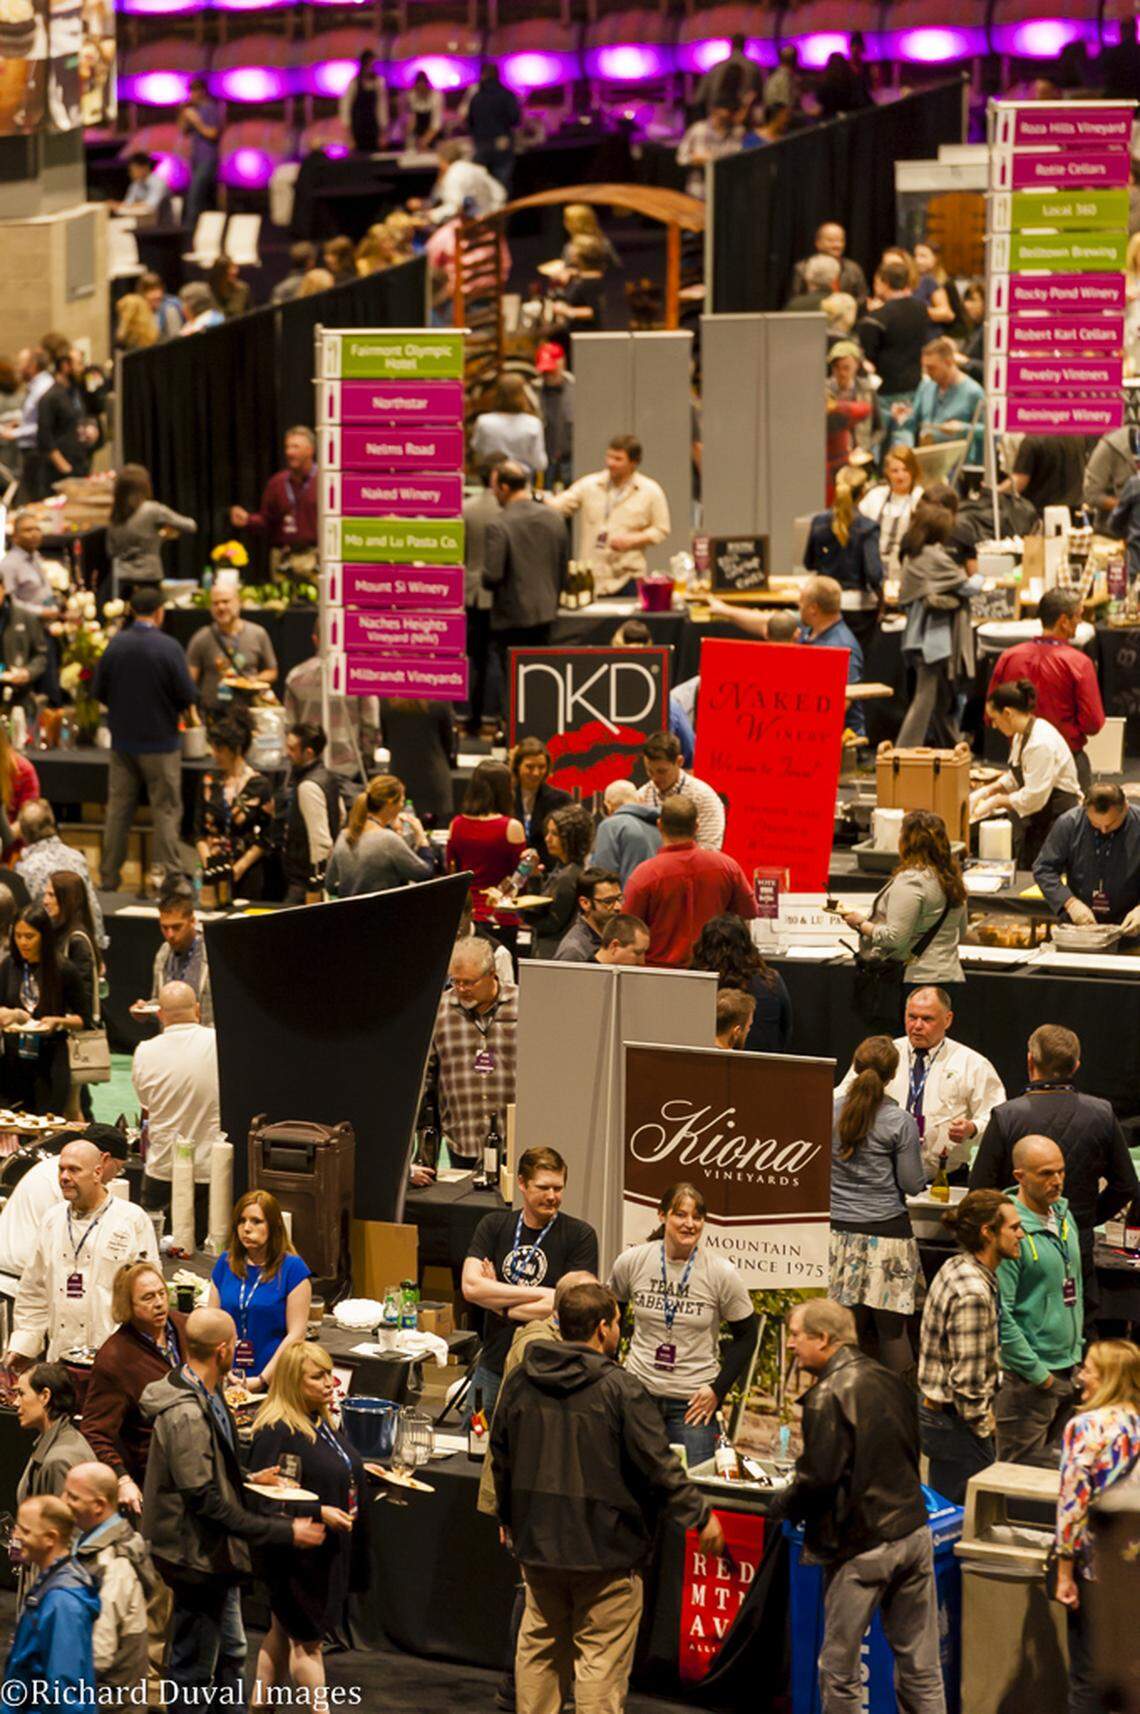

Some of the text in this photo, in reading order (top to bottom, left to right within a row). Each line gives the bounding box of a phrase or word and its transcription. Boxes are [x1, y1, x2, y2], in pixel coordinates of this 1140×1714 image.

[1050, 122, 1076, 134] Hills
[1077, 122, 1126, 136] Vineyard
[1068, 162, 1107, 176] Cellars
[1042, 204, 1072, 216] Local
[1072, 246, 1117, 260] Brewing
[1014, 287, 1120, 302] Rocky Pond Winery
[1014, 328, 1052, 340] Robert
[1079, 328, 1118, 340] Cellars
[351, 344, 452, 360] Fairmont Olympic
[385, 358, 417, 370] Hotel
[1019, 368, 1109, 383] Revelry Vintners
[372, 396, 428, 410] Northstar
[1016, 408, 1112, 424] Reininger Winery
[366, 442, 436, 456] Nelms Road
[361, 487, 441, 503] Naked Winery
[344, 534, 458, 548] Mo and Lu Pasta Co.
[355, 580, 449, 597] Mount Si Winery
[358, 616, 448, 633] Naches Heights
[366, 631, 409, 645] Vineyard
[350, 668, 463, 686] Millbrandt Vineyards
[710, 680, 831, 713] NAKED
[630, 1100, 822, 1173] Kiona
[703, 1169, 800, 1187] VINEYARDS
[705, 1235, 802, 1257] MOUNTAIN
[728, 1254, 824, 1278] SINCE 1975
[650, 1278, 690, 1298] TEAM
[693, 1552, 756, 1584] RED
[690, 1614, 731, 1640] AV
